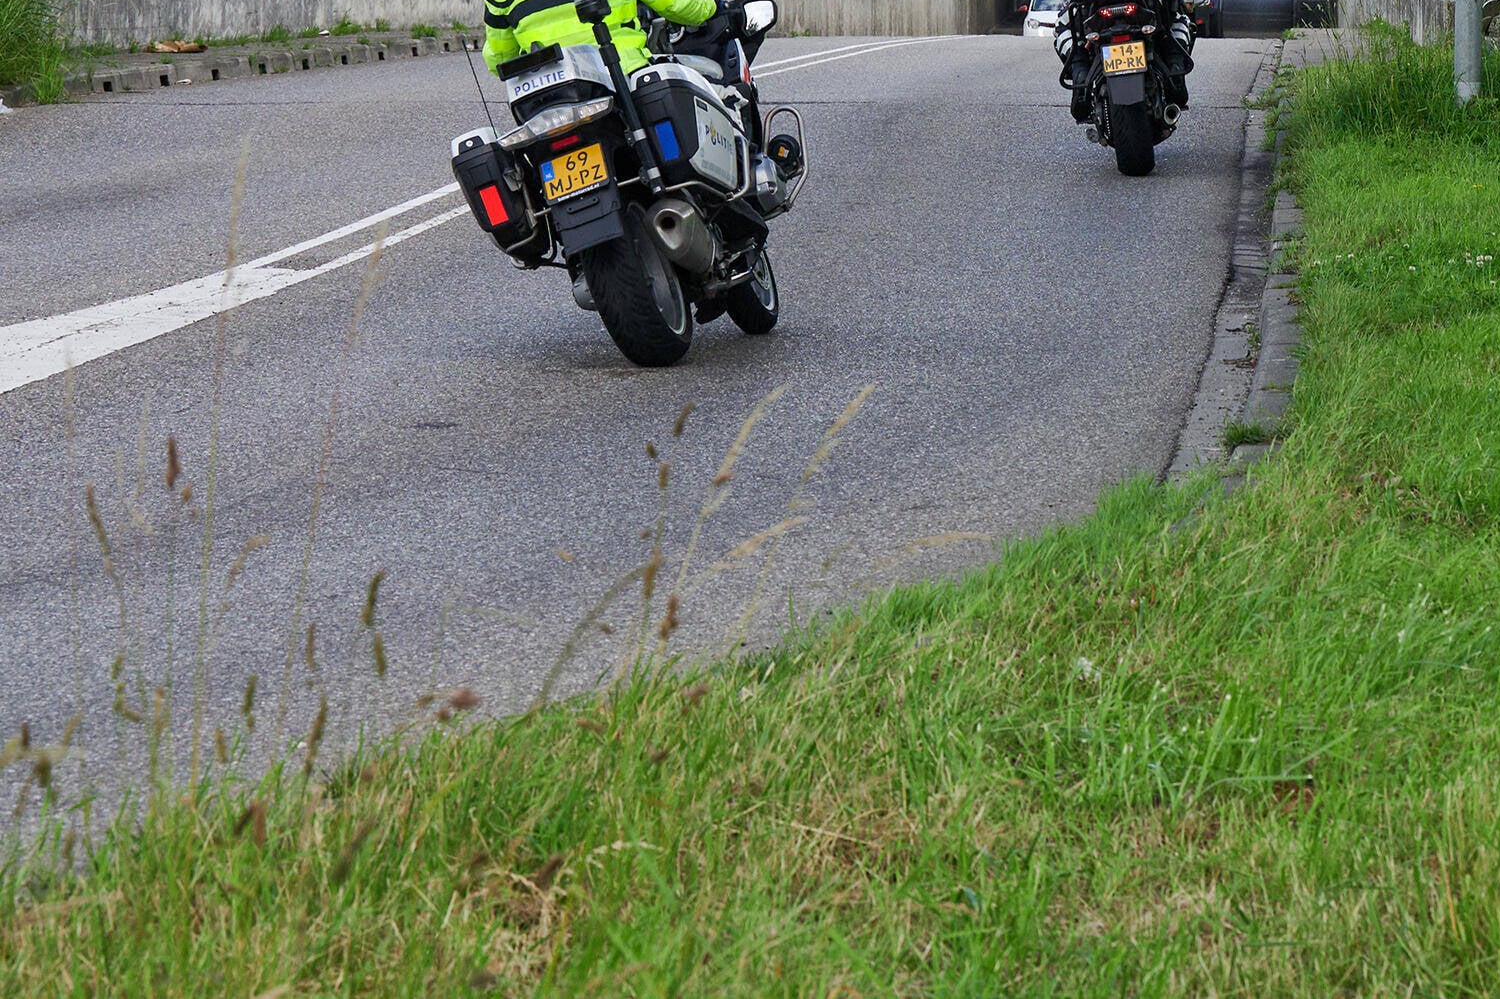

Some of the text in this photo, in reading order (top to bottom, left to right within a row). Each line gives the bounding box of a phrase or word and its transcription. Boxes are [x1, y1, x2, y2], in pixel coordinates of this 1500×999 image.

[1119, 44, 1134, 57] 14
[1105, 56, 1145, 71] MP-RK
[514, 70, 566, 96] POLITIE
[565, 151, 588, 171] 69
[549, 164, 603, 196] MJ-PZ
